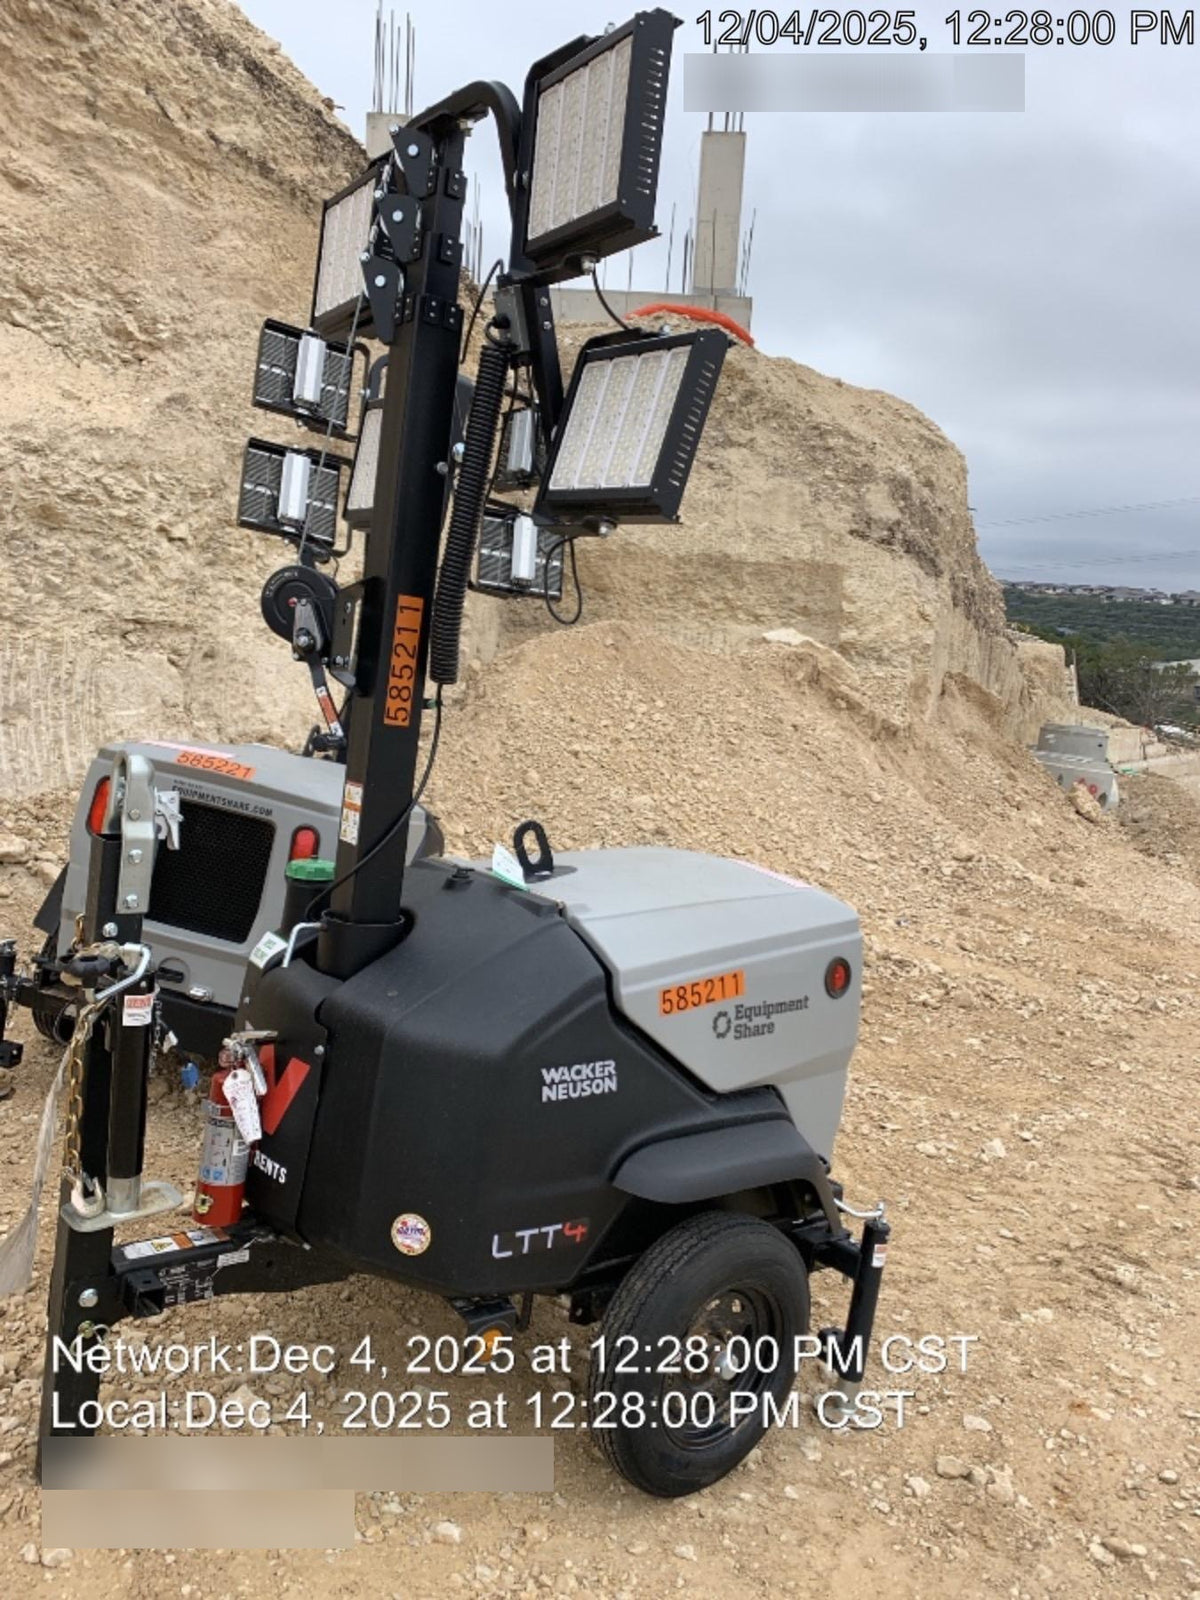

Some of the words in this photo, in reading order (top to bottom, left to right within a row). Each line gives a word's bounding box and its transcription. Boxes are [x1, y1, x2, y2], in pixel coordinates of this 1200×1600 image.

[385, 604, 421, 722] 585211
[661, 972, 740, 1015] 585211
[733, 994, 810, 1022] Equipment
[733, 1020, 776, 1040] Share
[540, 1059, 617, 1084] WACKER
[541, 1075, 618, 1102] NEUSON
[491, 1221, 588, 1259] LTT4
